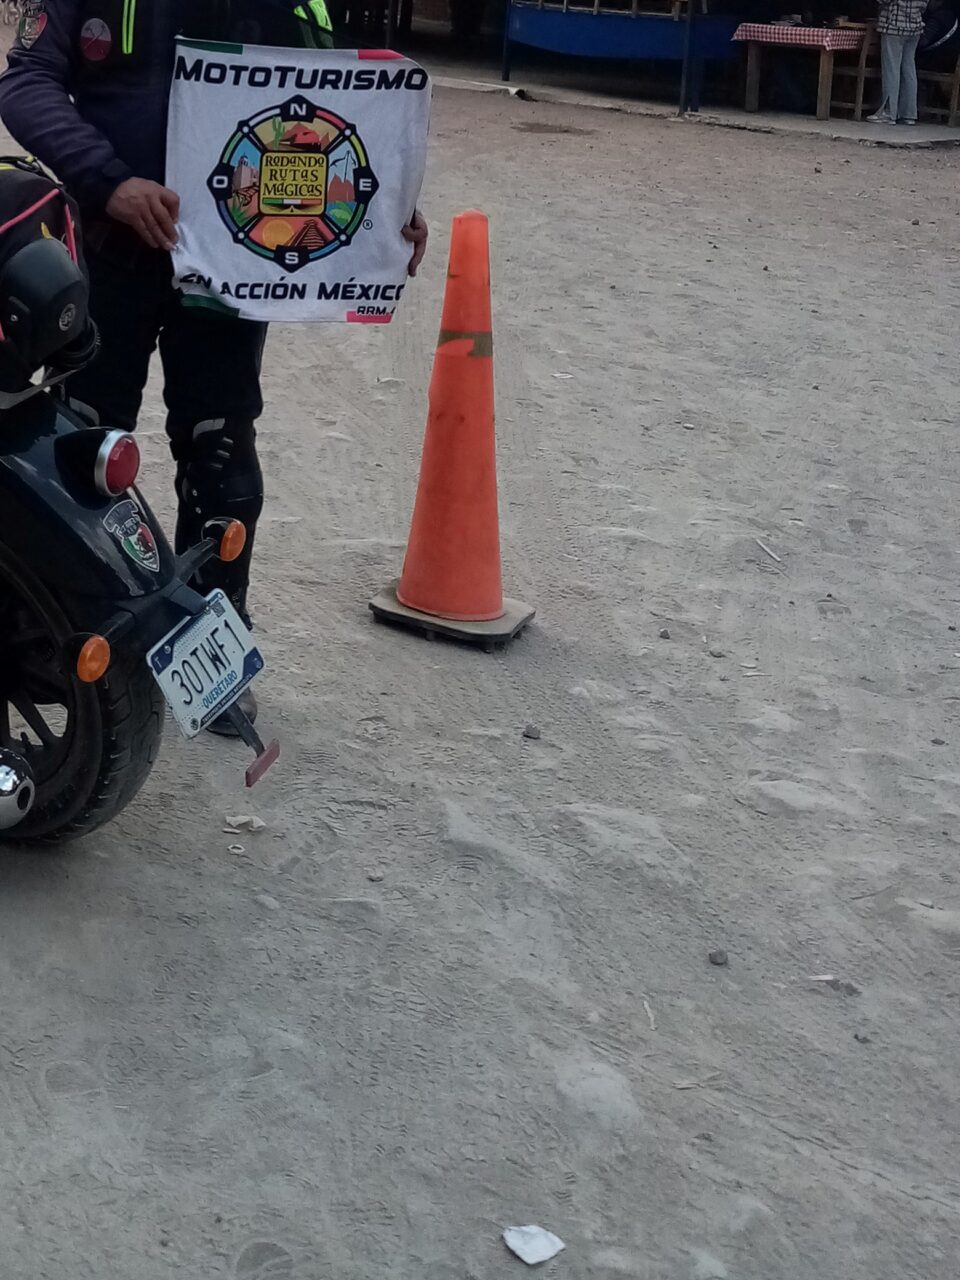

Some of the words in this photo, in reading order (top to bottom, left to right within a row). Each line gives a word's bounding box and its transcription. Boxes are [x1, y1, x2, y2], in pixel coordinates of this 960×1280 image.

[174, 55, 429, 91] MOTOTURISMO
[290, 103, 307, 116] N
[212, 176, 228, 188] O
[359, 178, 373, 192] E
[284, 252, 300, 265] S
[220, 276, 307, 301] ACCIÓN
[202, 669, 238, 709] QUERÉTARO
